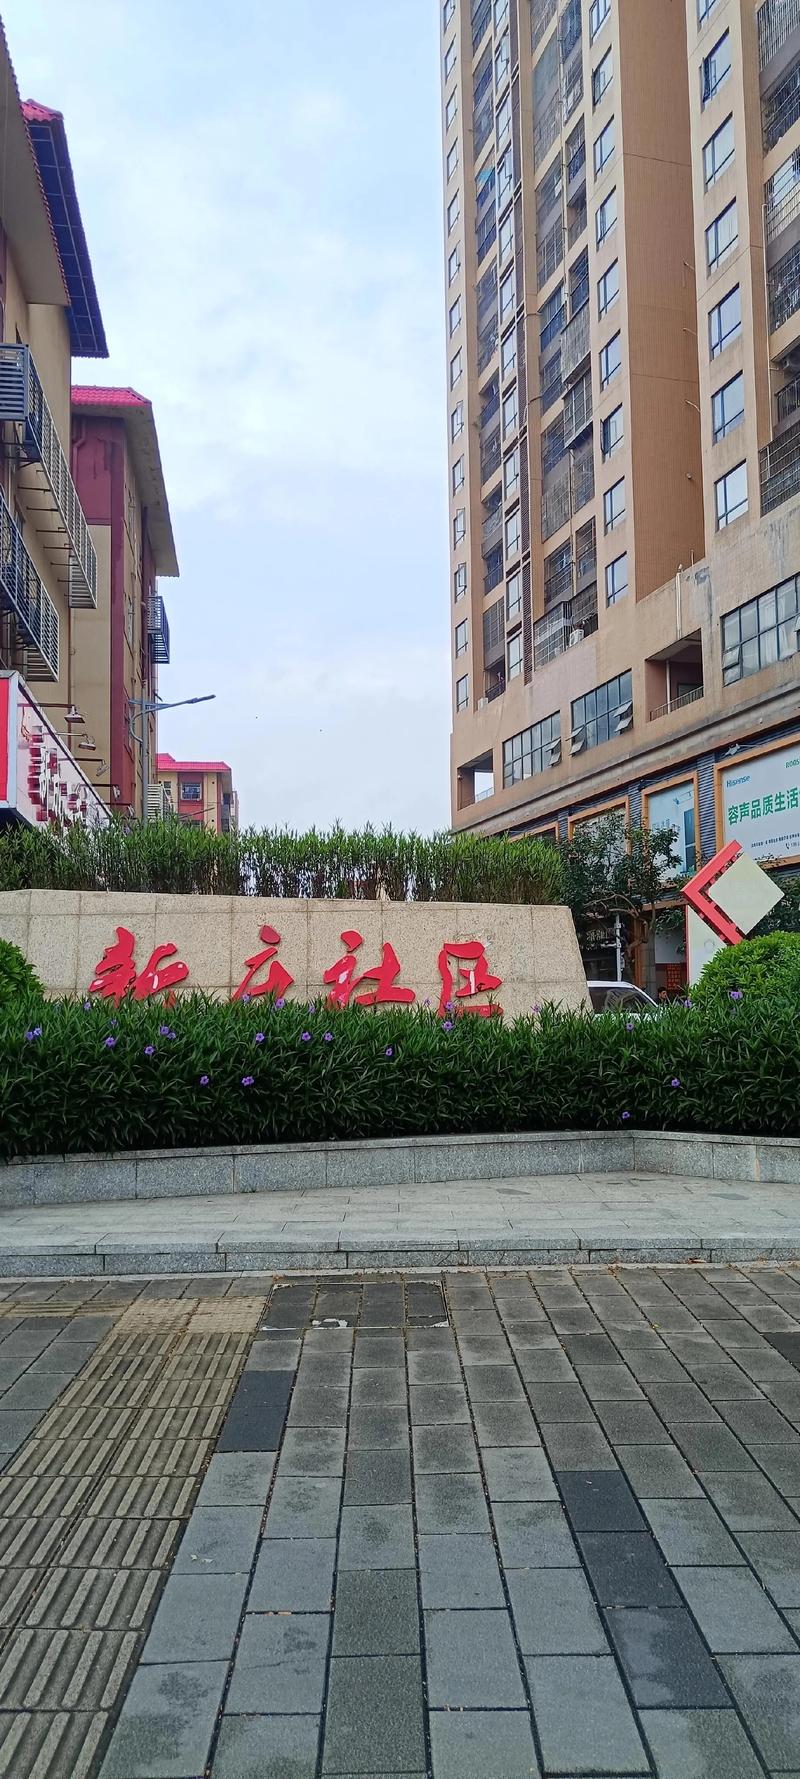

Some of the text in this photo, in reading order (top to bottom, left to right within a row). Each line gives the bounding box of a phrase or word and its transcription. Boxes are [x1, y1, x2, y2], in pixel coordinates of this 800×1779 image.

[726, 775, 751, 788] Hisense
[728, 786, 800, 826] 容声品质生活
[88, 925, 505, 1017] 新庄社区
